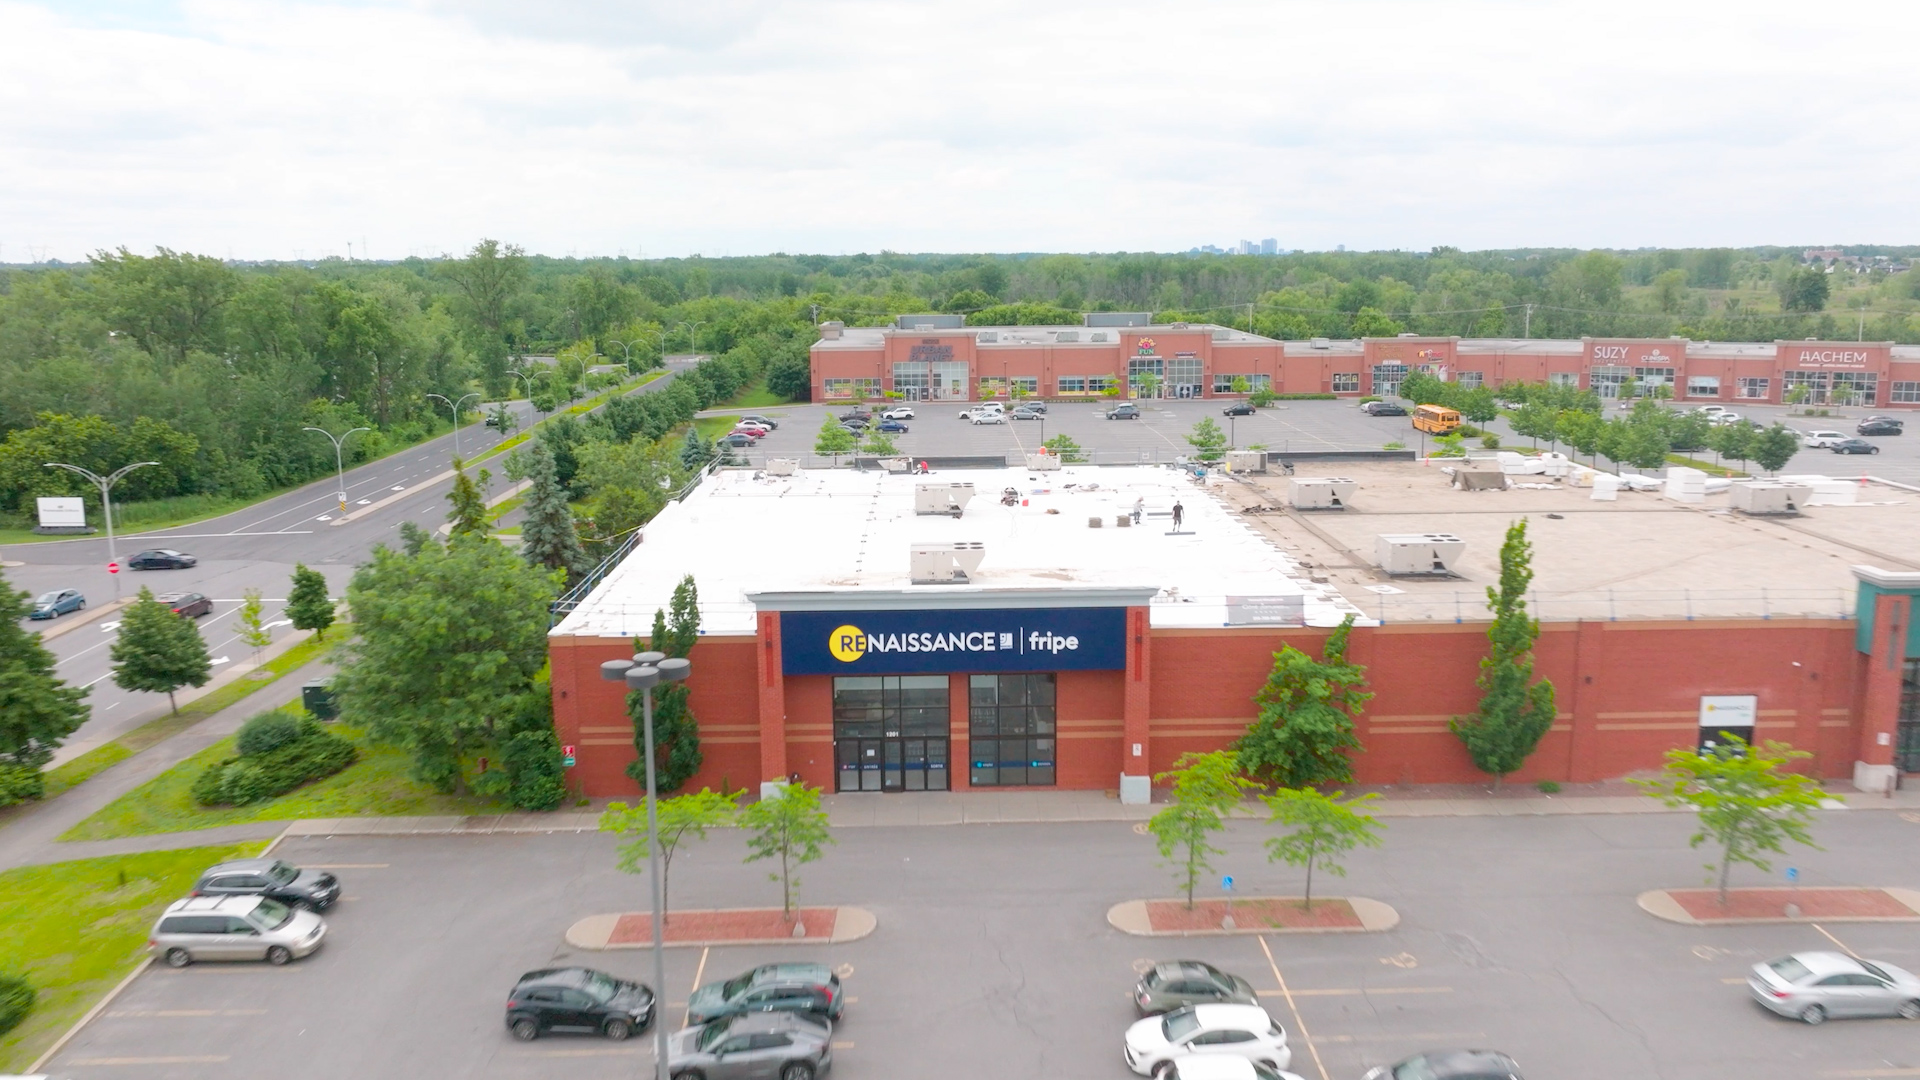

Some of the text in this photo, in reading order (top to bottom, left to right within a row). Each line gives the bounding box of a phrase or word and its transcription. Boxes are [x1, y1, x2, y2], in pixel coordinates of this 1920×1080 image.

[911, 345, 953, 353] URBAN
[1594, 346, 1629, 359] SUZY
[909, 353, 955, 362] PLANET
[1800, 351, 1867, 363] HACHEM
[840, 631, 1080, 654] RENAISSANCE fripe
